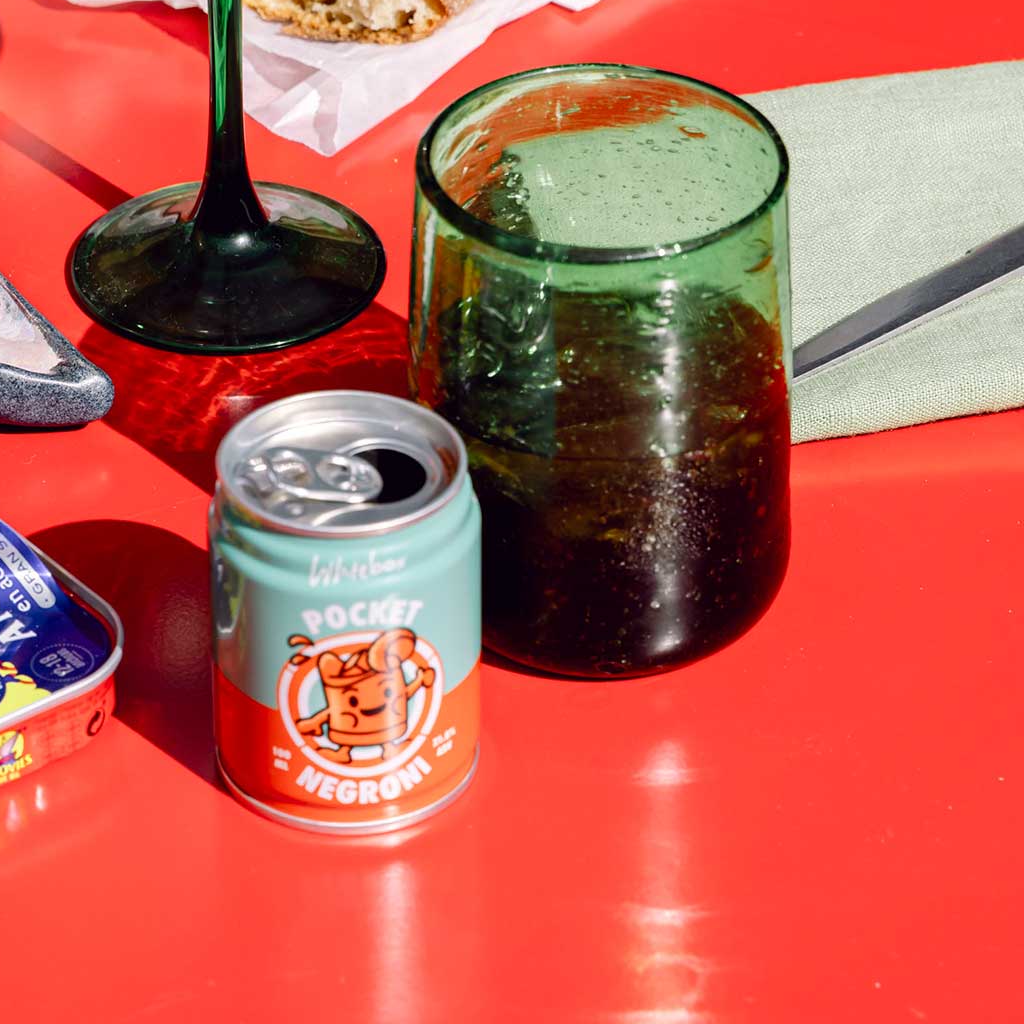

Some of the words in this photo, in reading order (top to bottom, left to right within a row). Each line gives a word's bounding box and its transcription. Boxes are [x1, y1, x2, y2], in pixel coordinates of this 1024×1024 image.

[8, 588, 32, 613] en
[301, 598, 424, 635] POCKET
[295, 755, 433, 805] NEGRONI
